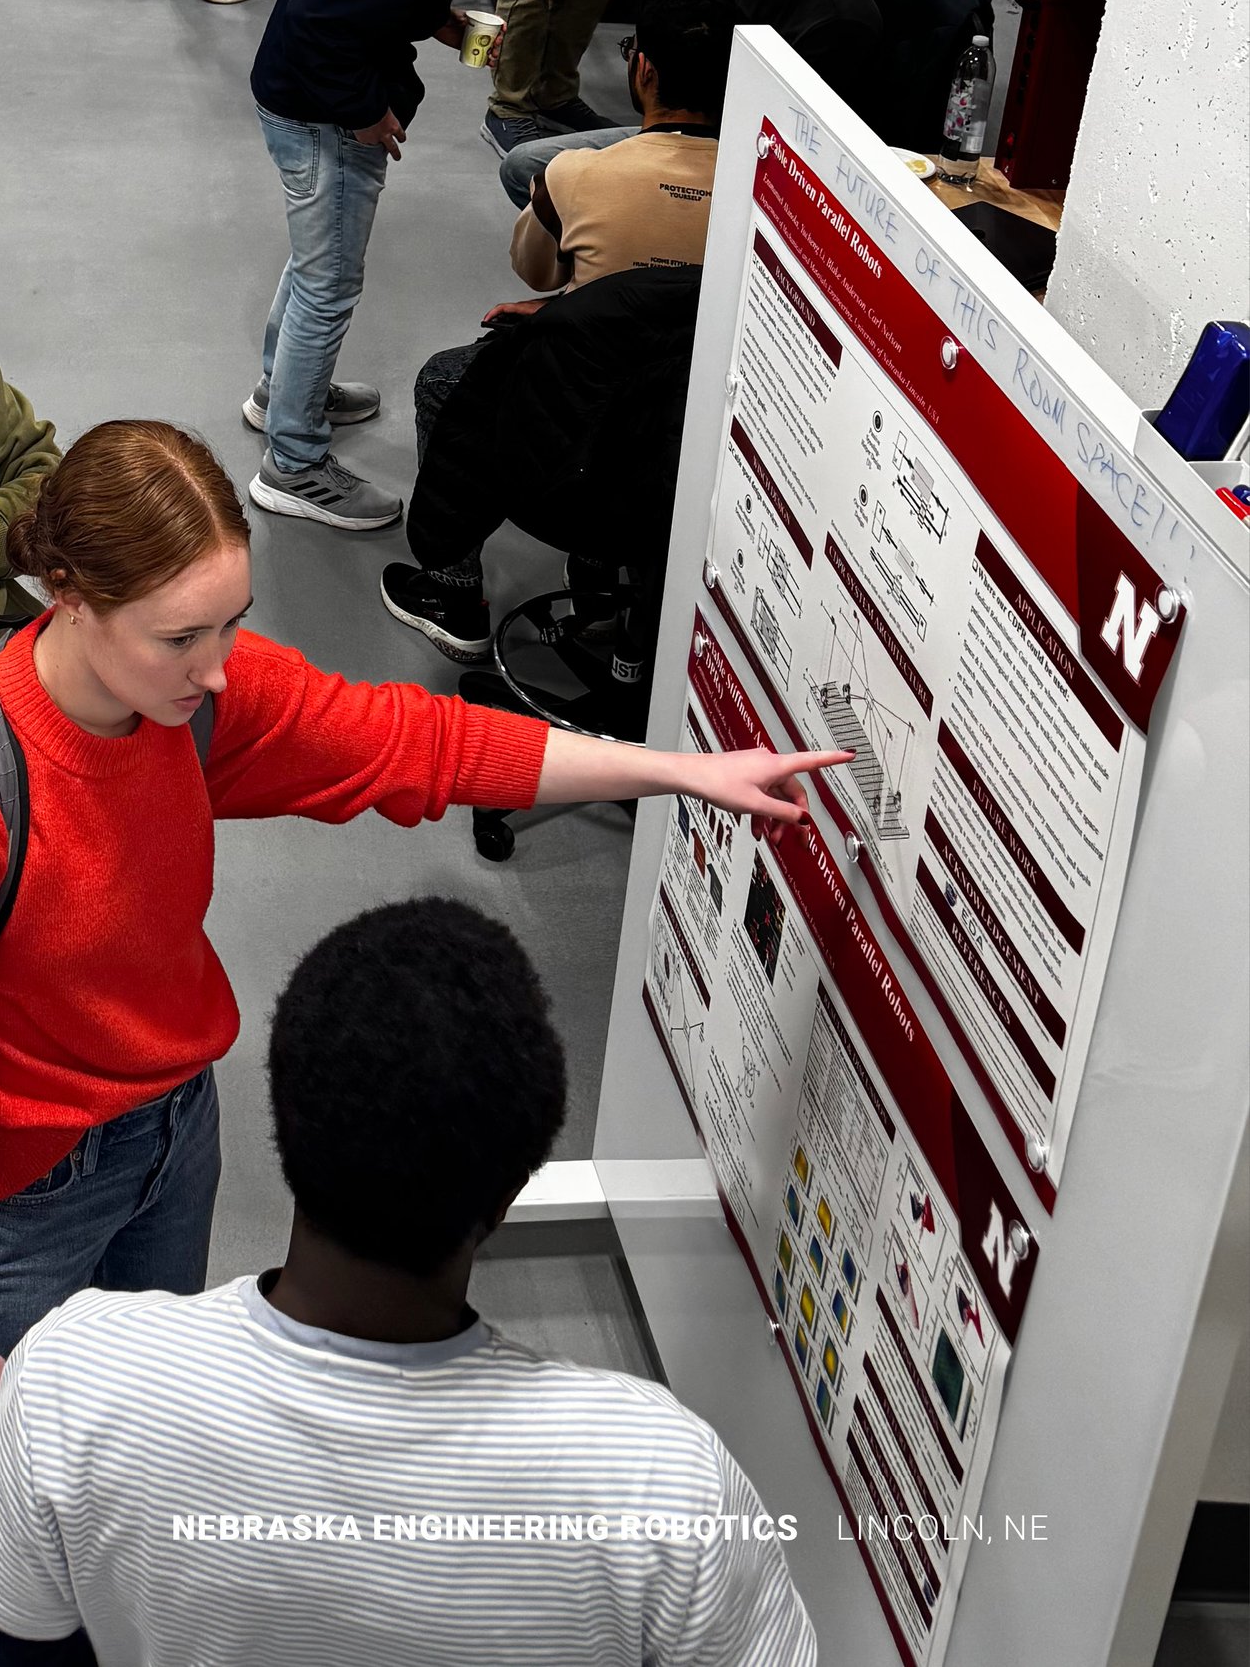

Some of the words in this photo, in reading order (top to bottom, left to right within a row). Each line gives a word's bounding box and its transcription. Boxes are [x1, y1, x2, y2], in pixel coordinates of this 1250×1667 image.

[659, 183, 712, 197] PROTECTION
[670, 192, 702, 201] YOURSELF
[787, 155, 816, 204] Driven
[816, 188, 851, 245] Parallel
[849, 227, 883, 282] Robots
[775, 263, 816, 330] BACKGROUND
[789, 103, 821, 157] THE
[835, 151, 902, 244] FUTURE
[915, 249, 941, 285] OF
[949, 276, 1001, 351] THIS
[1012, 347, 1067, 435] ROOM
[825, 254, 841, 283] Blake
[840, 272, 867, 315] Anderson,
[867, 304, 881, 330] Carl
[882, 322, 902, 355] Nelson
[828, 543, 846, 578] CDPR
[845, 569, 874, 623] SYSTEM
[873, 612, 928, 709] ARCHITECTURE
[977, 567, 996, 600] Where
[995, 594, 1007, 616] our
[1006, 608, 1026, 643] CDPR
[1026, 636, 1044, 667] could
[1043, 660, 1053, 680] be
[1014, 588, 1075, 682] APPLICATION
[1100, 571, 1161, 687] N
[725, 669, 754, 736] Stiffness
[817, 847, 846, 913] Driven
[846, 902, 882, 982] Parallel
[880, 968, 916, 1046] Robots
[972, 777, 1008, 841] FUTURE
[1008, 830, 1038, 887] WORK
[941, 841, 1040, 1008] ACKNOWLEDGEMENT
[951, 921, 1011, 1028] REFERENCES
[960, 905, 985, 954] EDA
